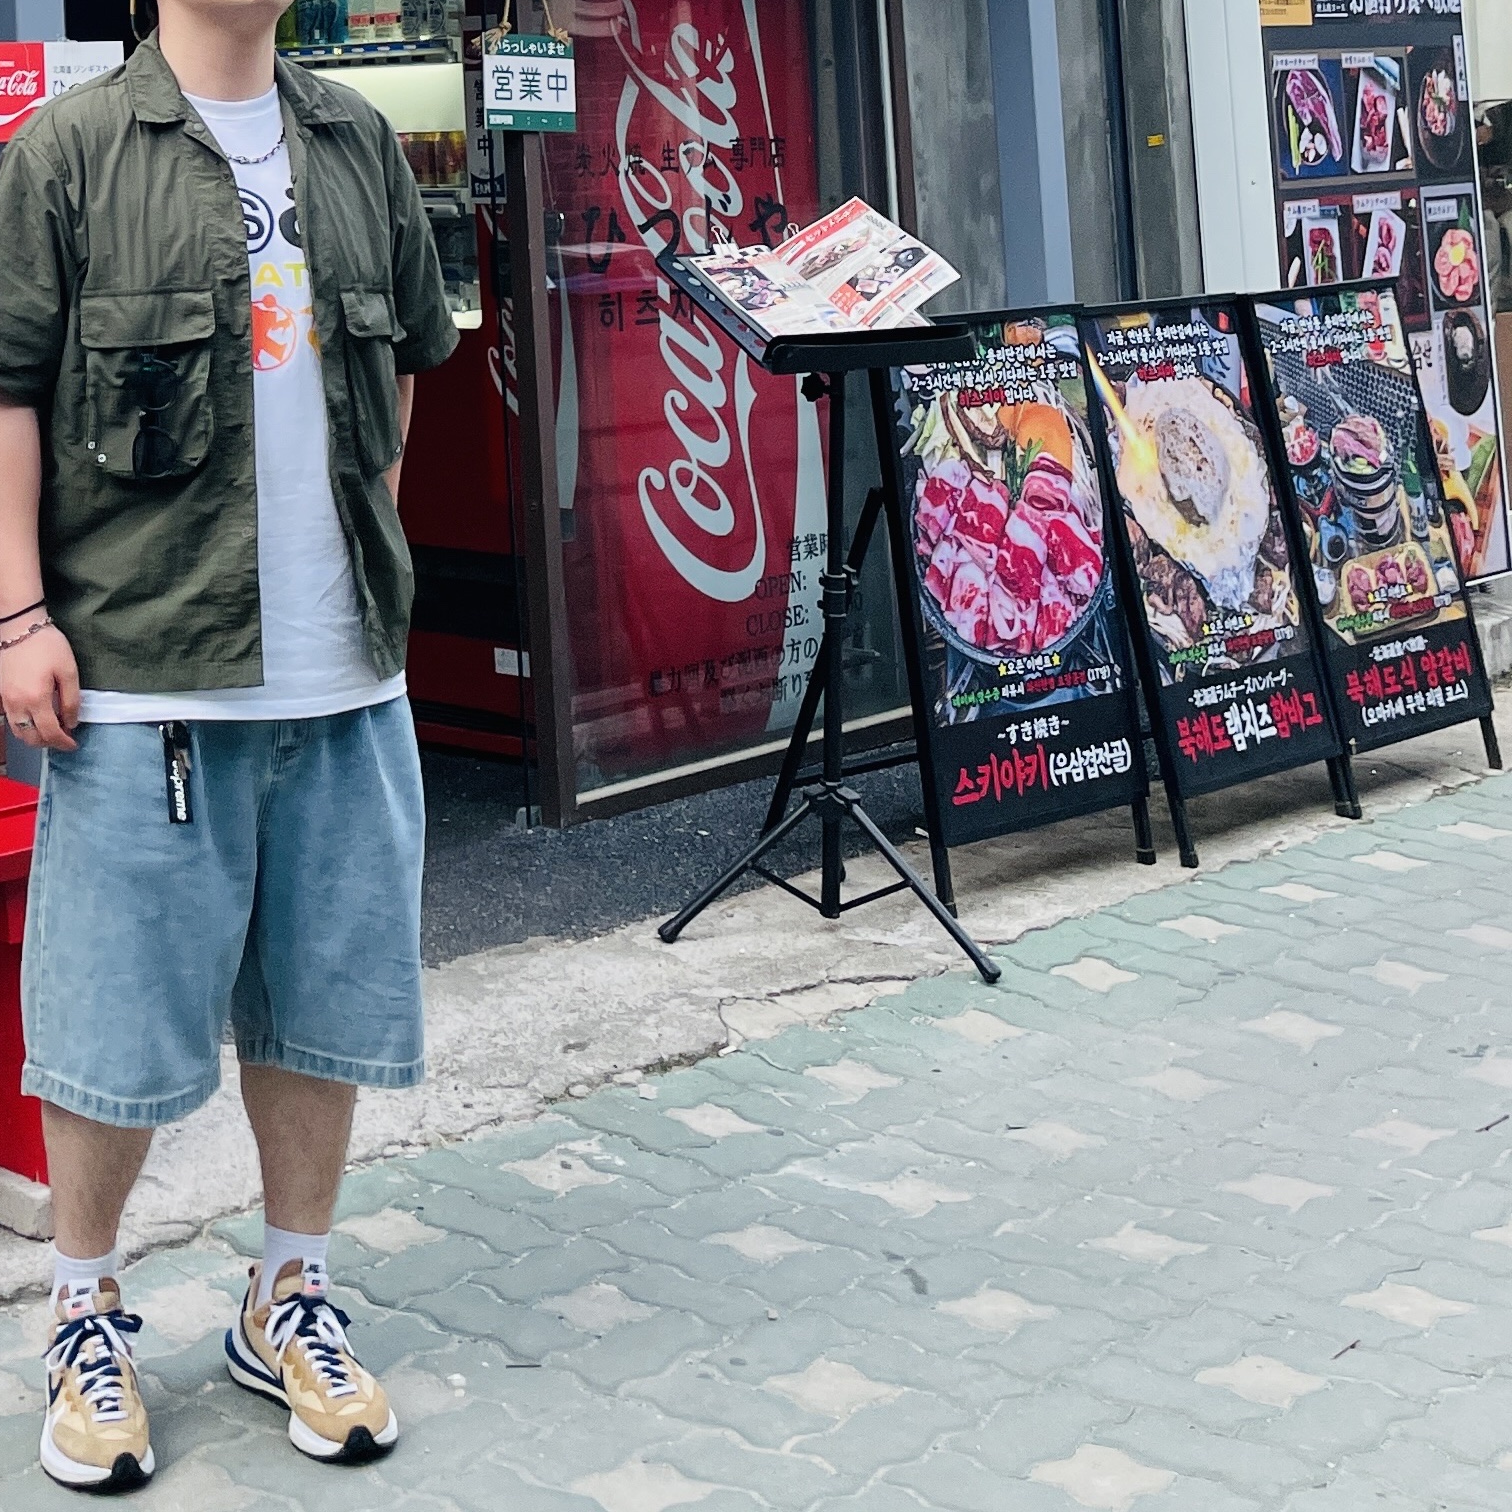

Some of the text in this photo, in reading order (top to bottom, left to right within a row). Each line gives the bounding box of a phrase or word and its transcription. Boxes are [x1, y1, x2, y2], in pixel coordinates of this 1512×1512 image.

[491, 64, 569, 103] 営業中
[755, 570, 808, 600] OPEN:
[746, 604, 809, 637] CLOSE:
